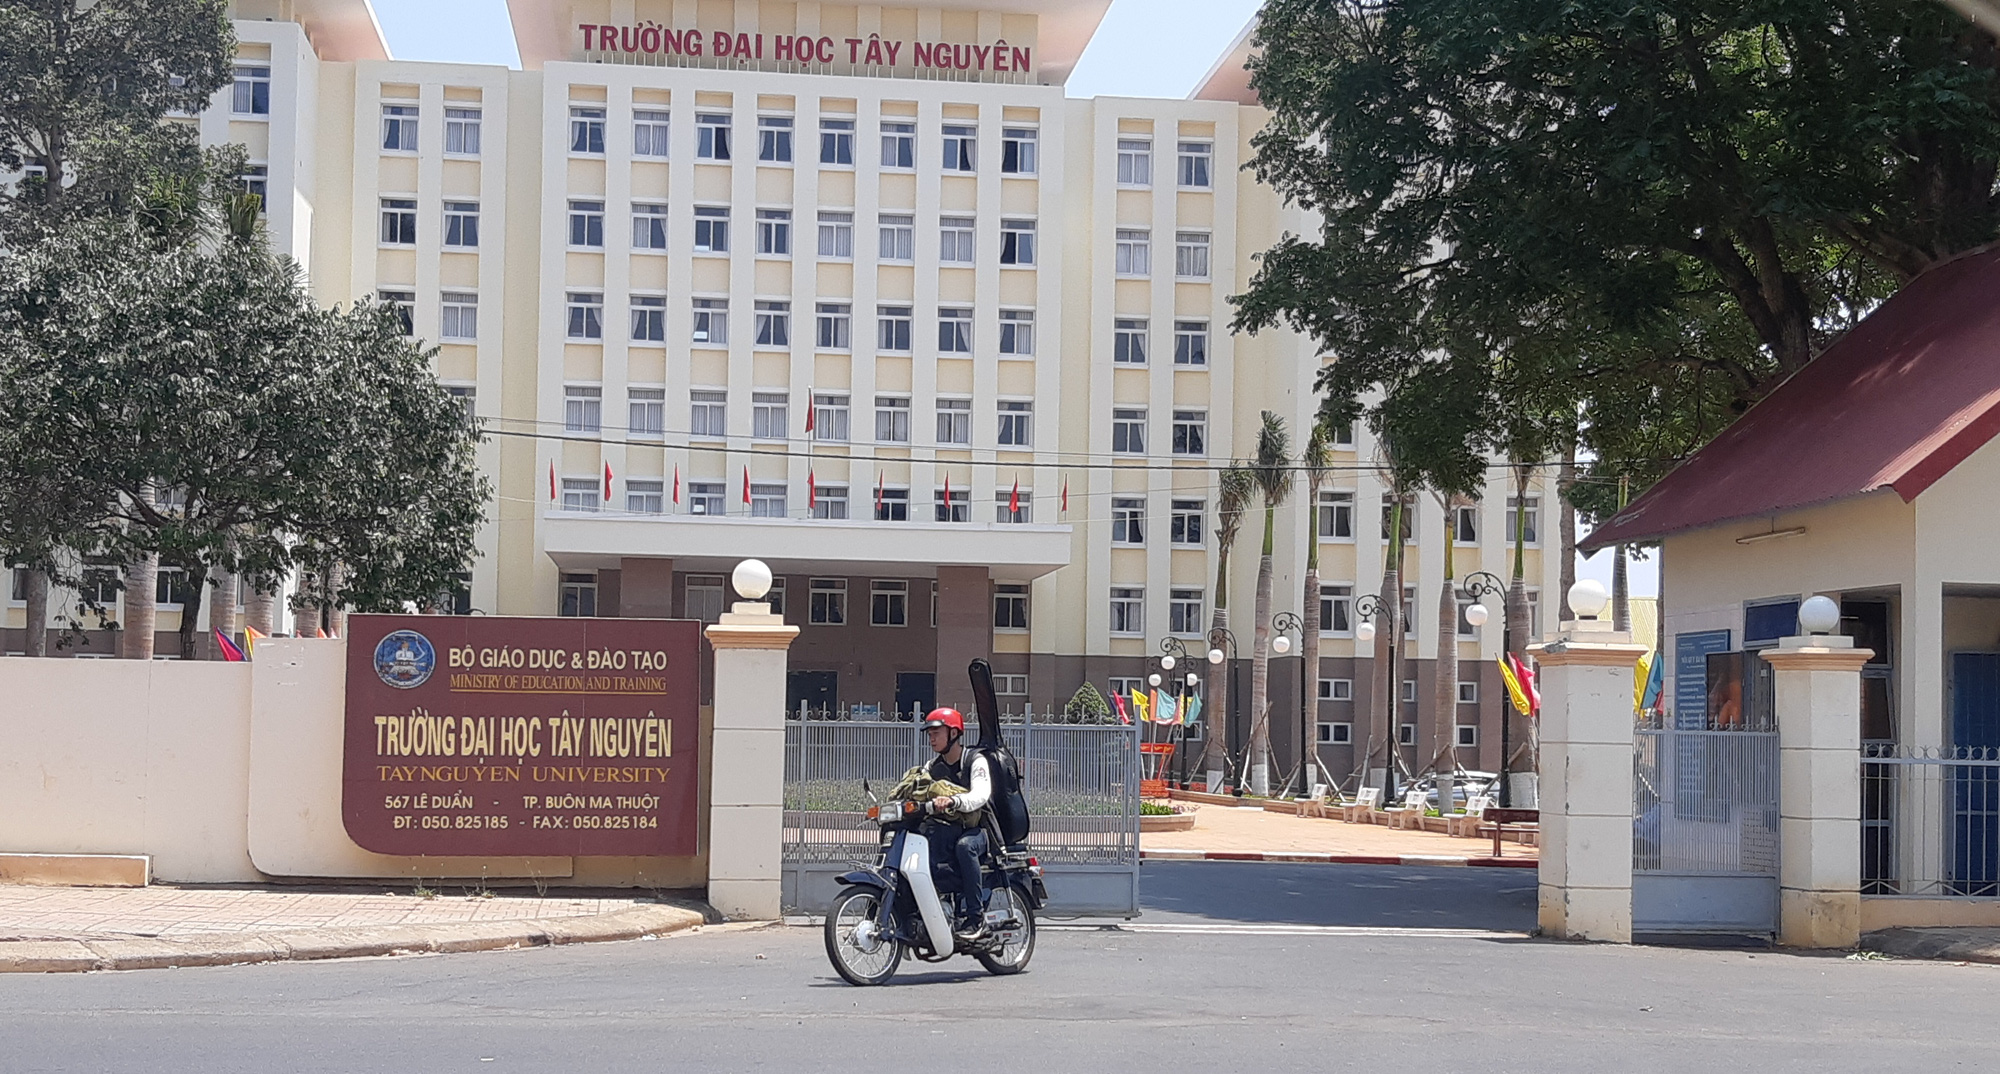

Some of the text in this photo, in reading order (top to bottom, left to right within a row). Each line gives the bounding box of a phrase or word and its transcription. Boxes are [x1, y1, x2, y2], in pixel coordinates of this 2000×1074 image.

[579, 20, 1030, 73] TRƯỜNG ĐẠI HỌC TÂY NGUYÊN
[449, 644, 667, 673] BỘ GIÁO DỤC & ĐÀO TẠO
[450, 674, 666, 691] MINISTRY OF EDUCATION AND TRAINING
[374, 706, 672, 765] TRƯỜNG ĐẠI HỌC TÂY NGUYÊN
[532, 766, 671, 783] UNIVERSITY
[384, 796, 410, 809] 567
[414, 793, 428, 809] LÊ
[432, 789, 473, 809] DUẨN
[523, 796, 541, 809] TP.
[545, 793, 586, 809] BUÔN
[589, 796, 613, 809] MA
[616, 793, 660, 812] THUỘT
[533, 816, 569, 829] FAX:
[573, 816, 658, 829] 050.825184
